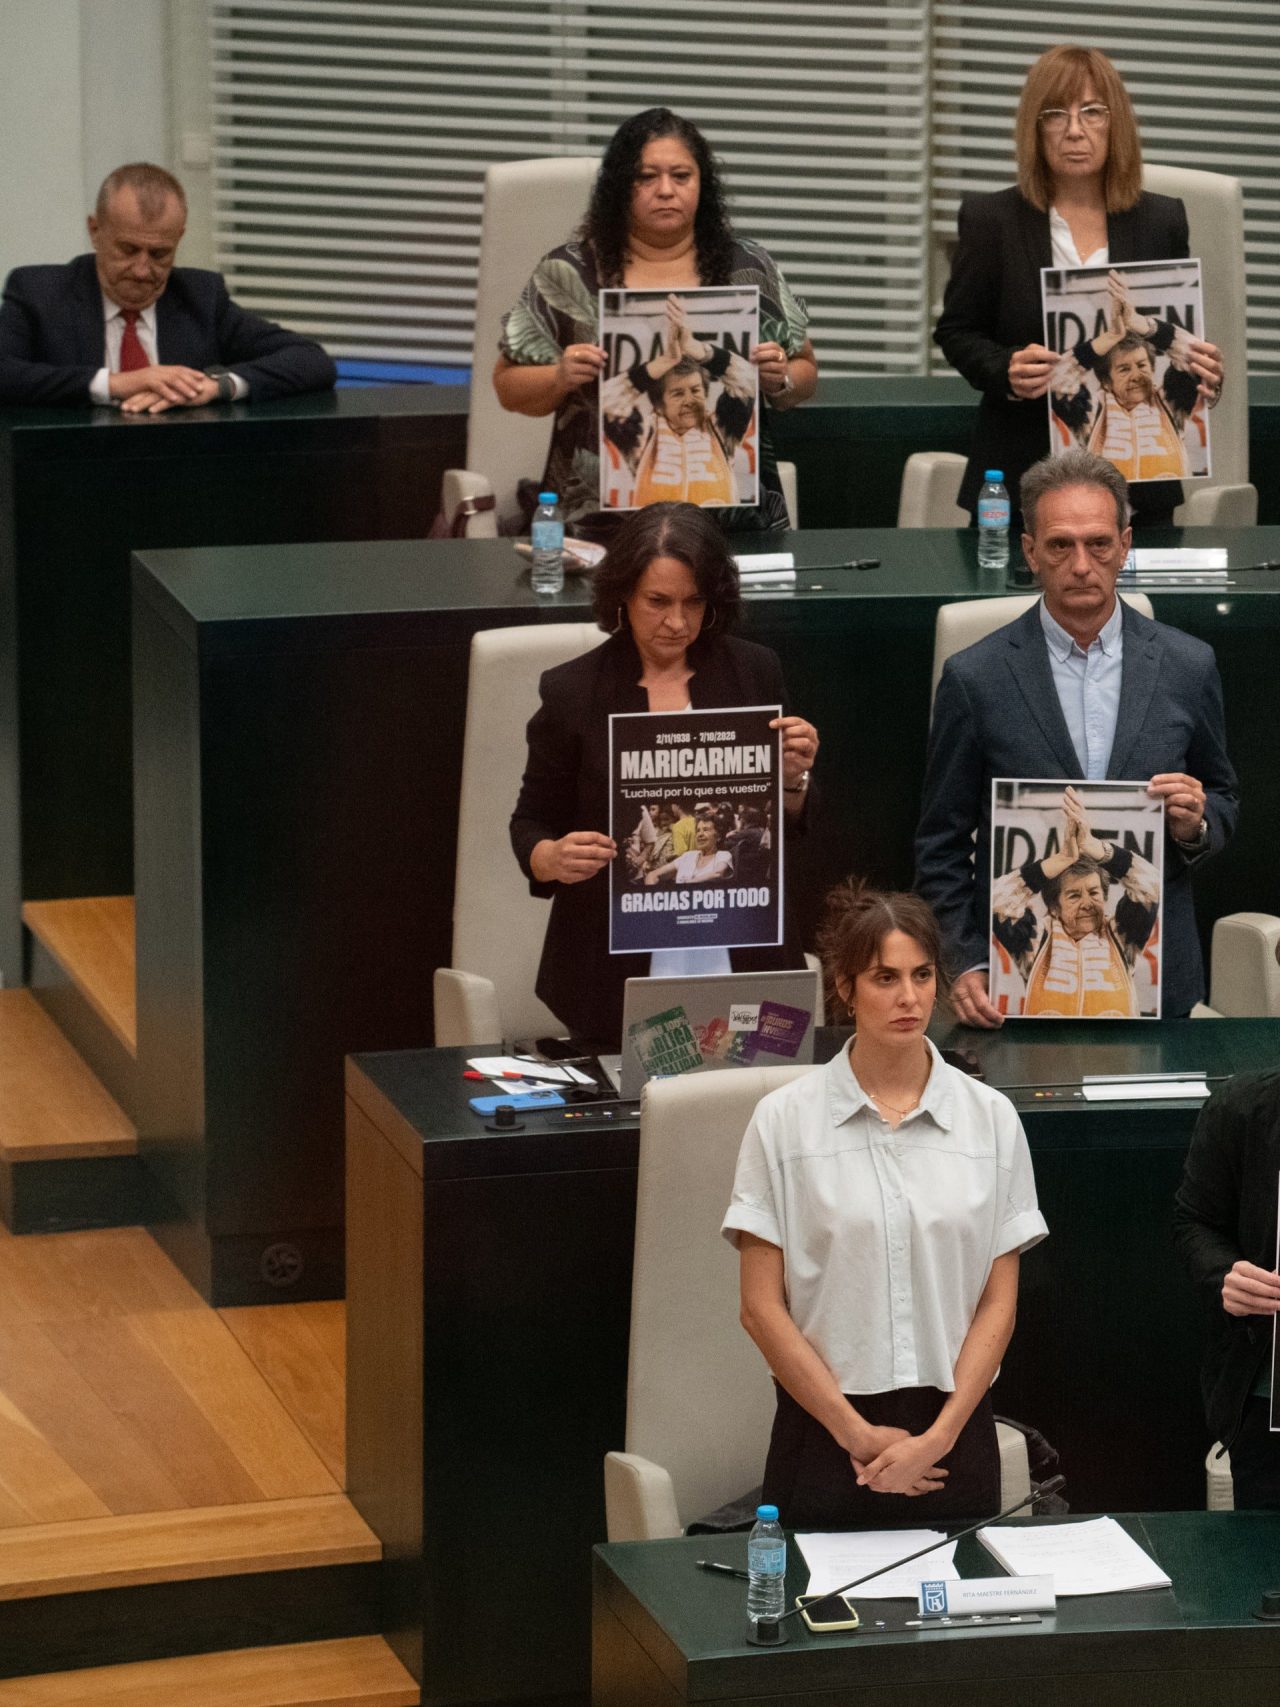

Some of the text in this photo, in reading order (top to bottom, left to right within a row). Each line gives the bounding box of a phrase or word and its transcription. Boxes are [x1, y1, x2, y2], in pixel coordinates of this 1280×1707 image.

[621, 744, 770, 780] MARICARMEN
[664, 789, 682, 799] por
[684, 787, 692, 796] lo
[694, 786, 714, 797] que
[715, 786, 728, 794] es
[621, 887, 770, 913] GRACIAS POR TODO
[977, 1590, 1002, 1598] MAESTRE
[1004, 1588, 1037, 1596] FERNÁNDEZ
